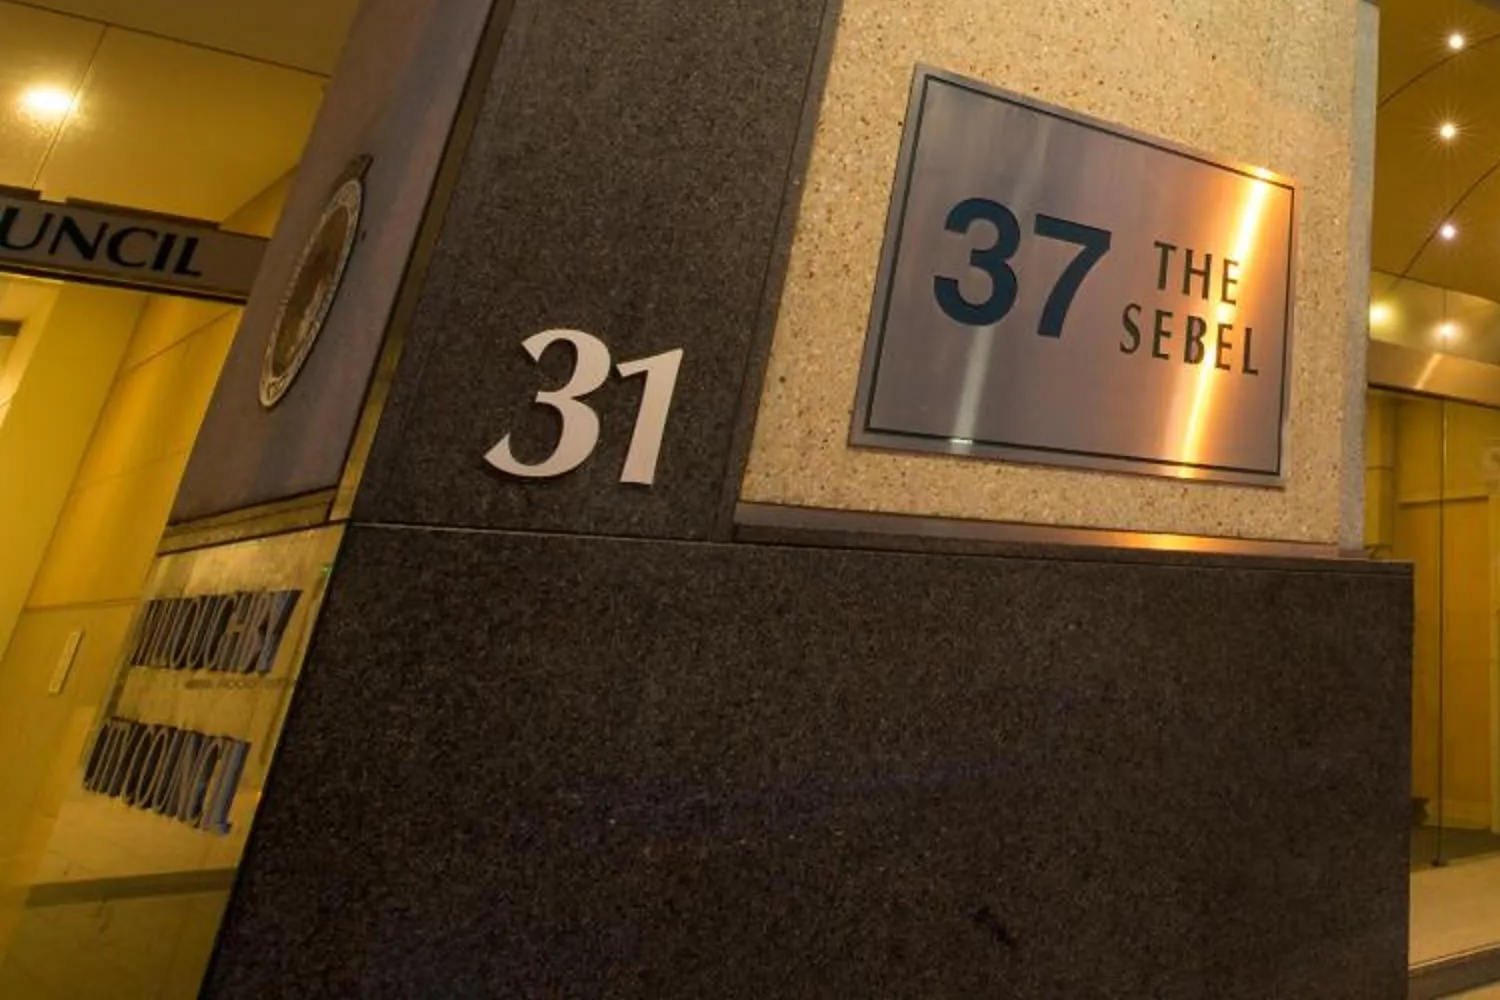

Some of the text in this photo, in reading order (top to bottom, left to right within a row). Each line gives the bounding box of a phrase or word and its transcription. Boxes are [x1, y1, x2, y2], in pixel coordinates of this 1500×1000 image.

[0, 207, 203, 278] UNCIL
[933, 198, 1112, 339] 37
[1154, 241, 1240, 307] THE
[1118, 303, 1259, 376] SEBEL
[484, 328, 684, 485] 31
[130, 589, 303, 675] WILLOUGHBY
[84, 716, 252, 834] CITY COUNCIL
